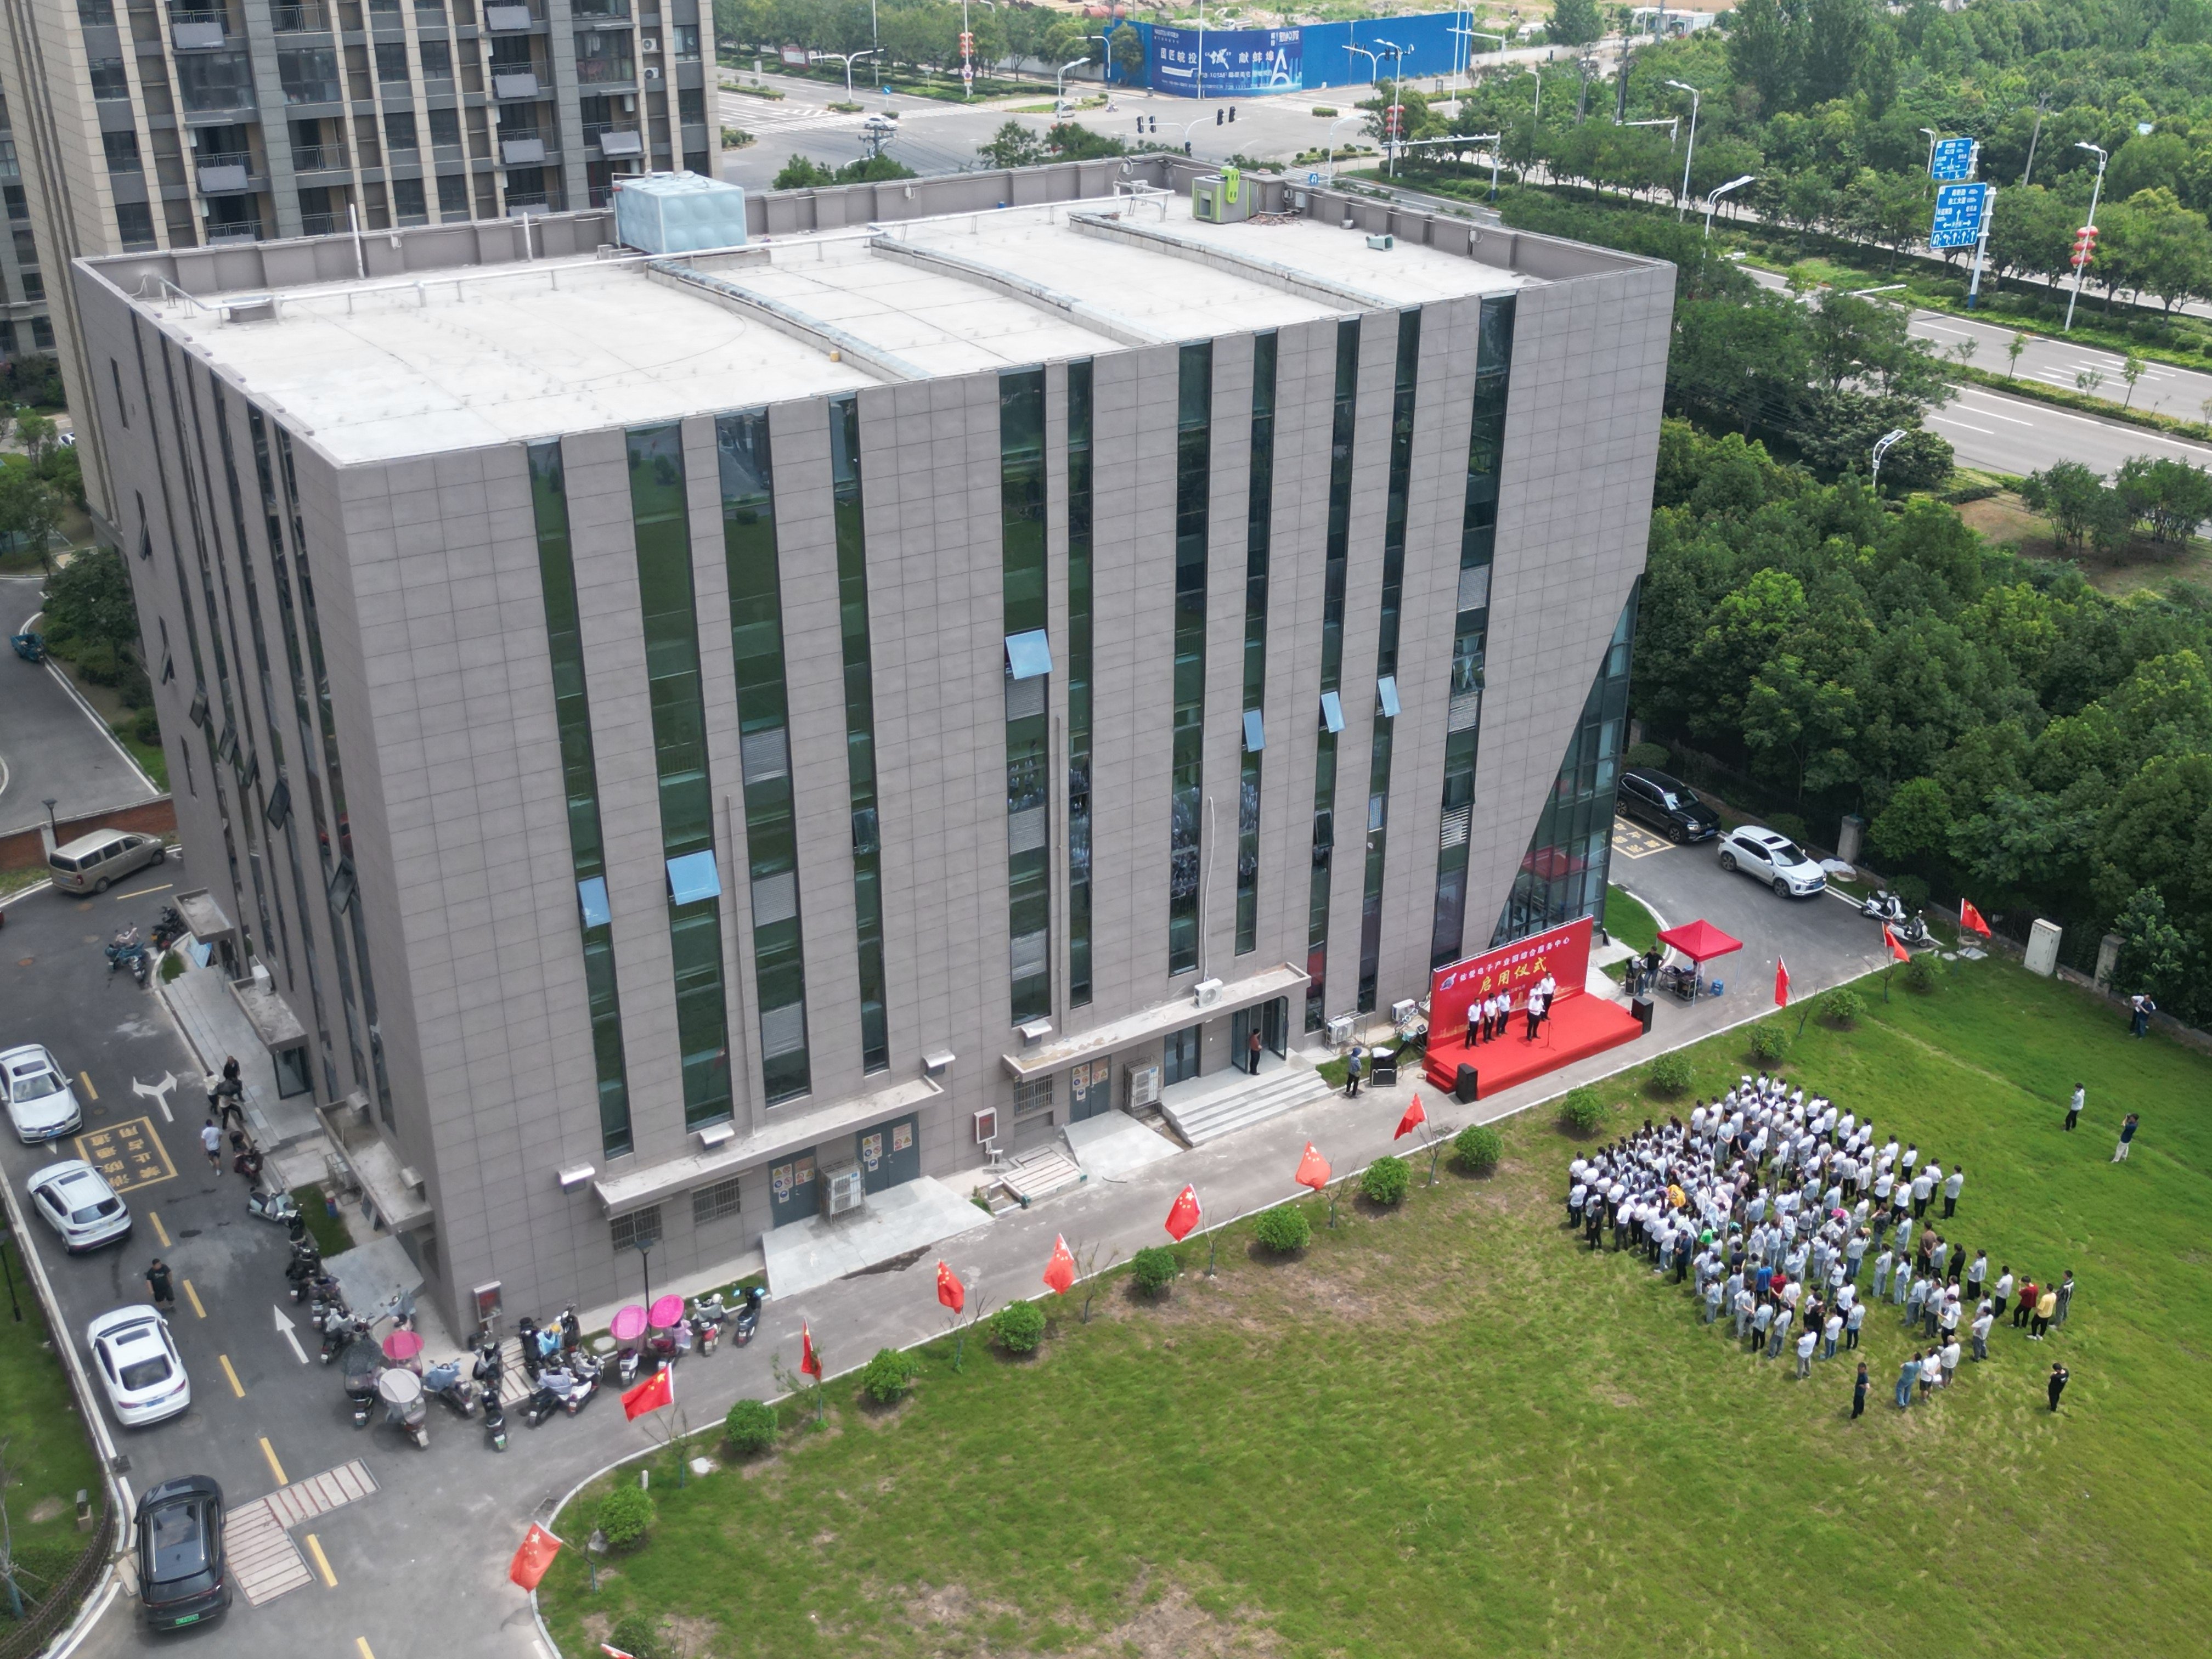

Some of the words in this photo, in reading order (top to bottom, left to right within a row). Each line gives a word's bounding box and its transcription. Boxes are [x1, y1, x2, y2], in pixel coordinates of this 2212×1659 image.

[1480, 956, 1547, 994] 启用仪式
[119, 1126, 161, 1178] 禁止占用
